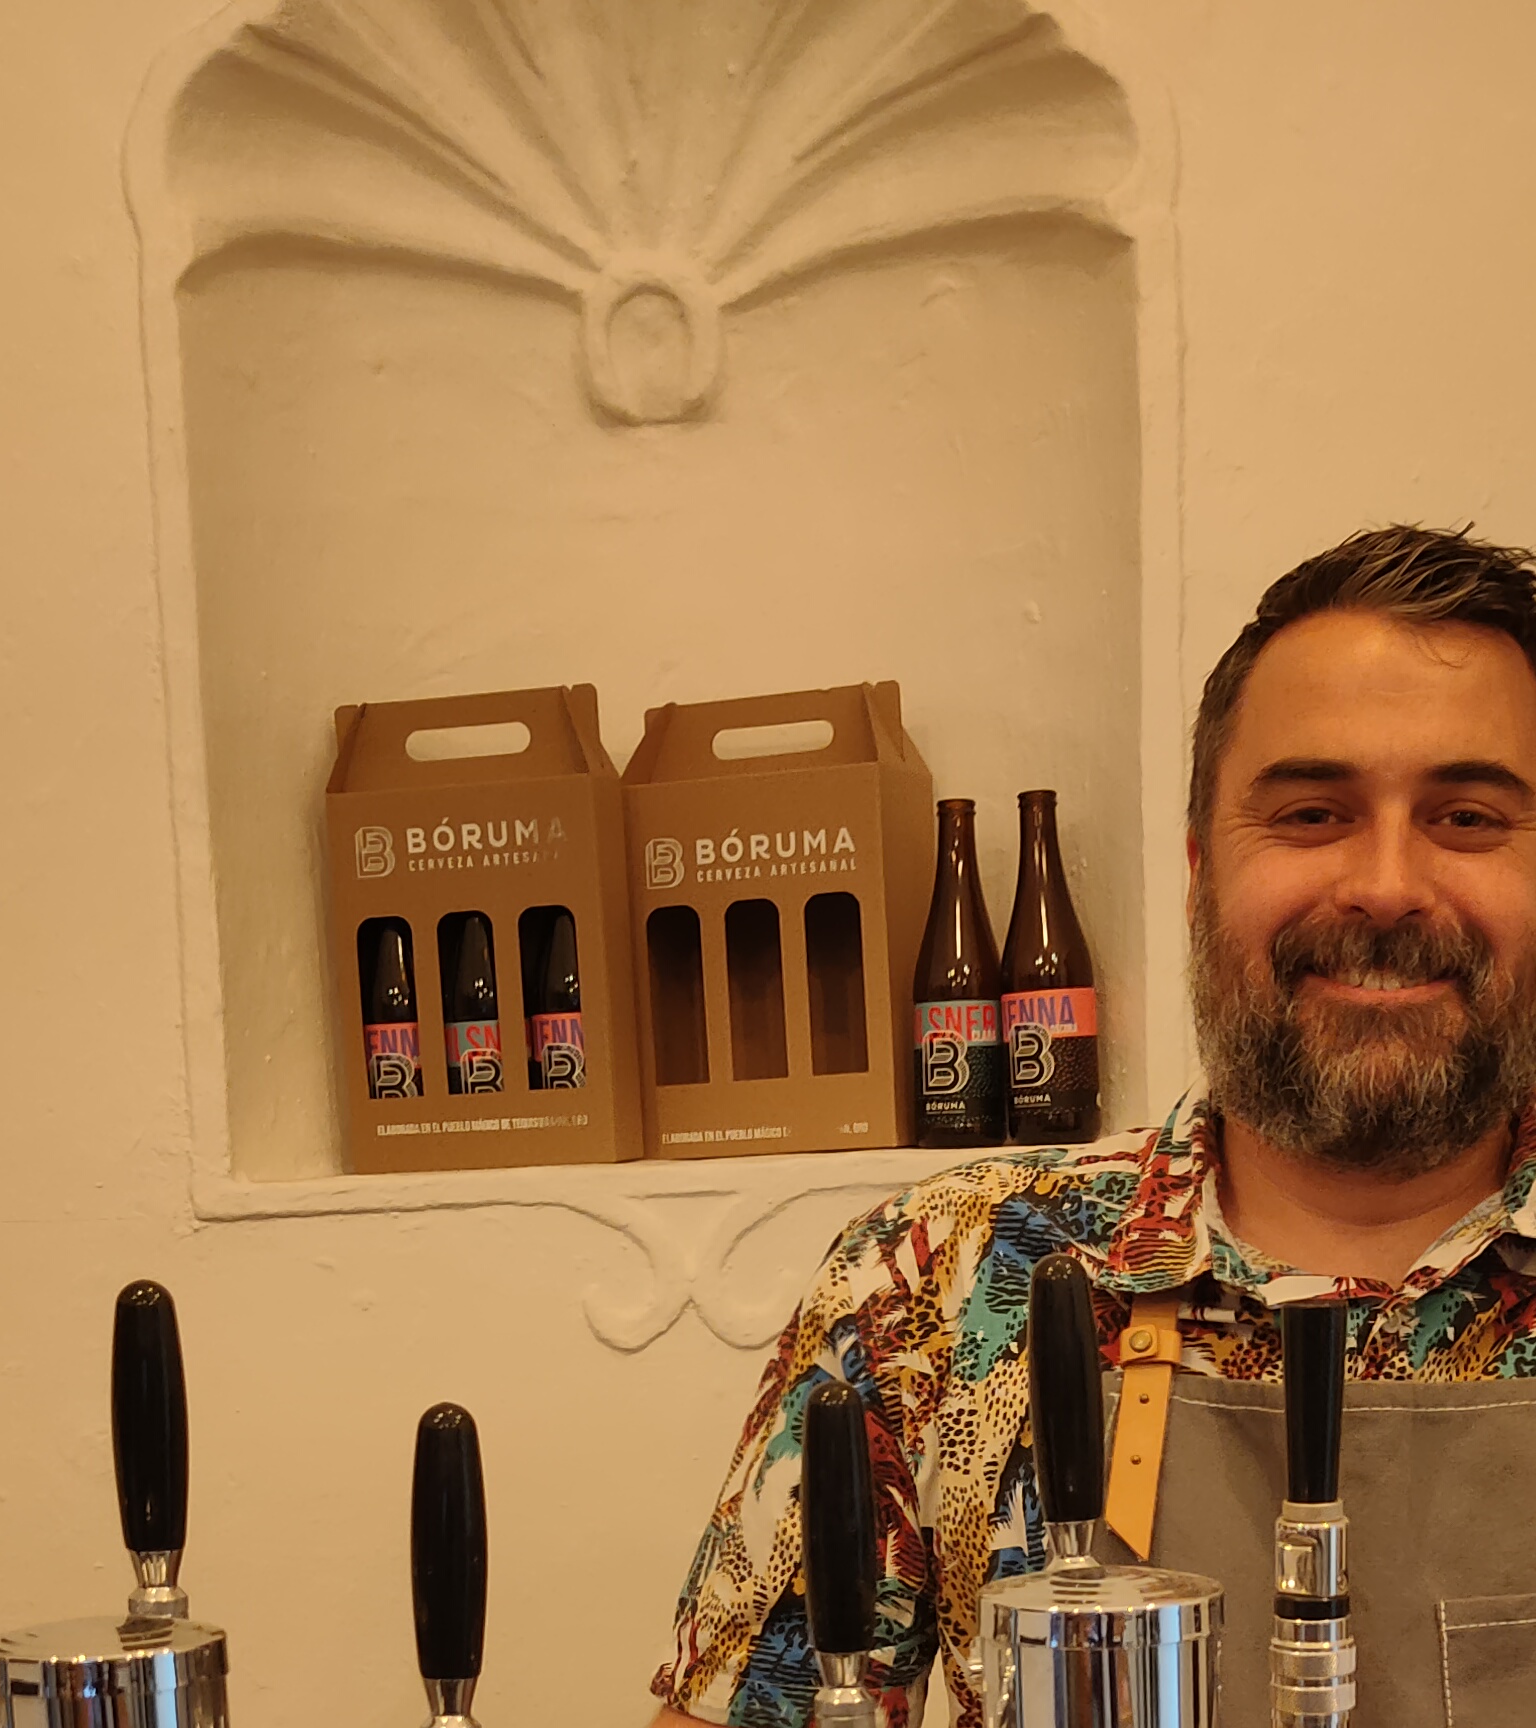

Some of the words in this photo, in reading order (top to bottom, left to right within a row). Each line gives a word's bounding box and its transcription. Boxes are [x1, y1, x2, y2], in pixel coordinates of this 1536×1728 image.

[406, 817, 567, 854] BÓRUMA
[695, 827, 856, 865] BÓRUMA
[409, 855, 474, 872] CERVEZA
[696, 866, 762, 883] CERVEZA
[770, 858, 857, 876] ARTESANAL
[926, 1100, 966, 1111] BÓRUMA
[1014, 1093, 1052, 1105] BÓRUMA
